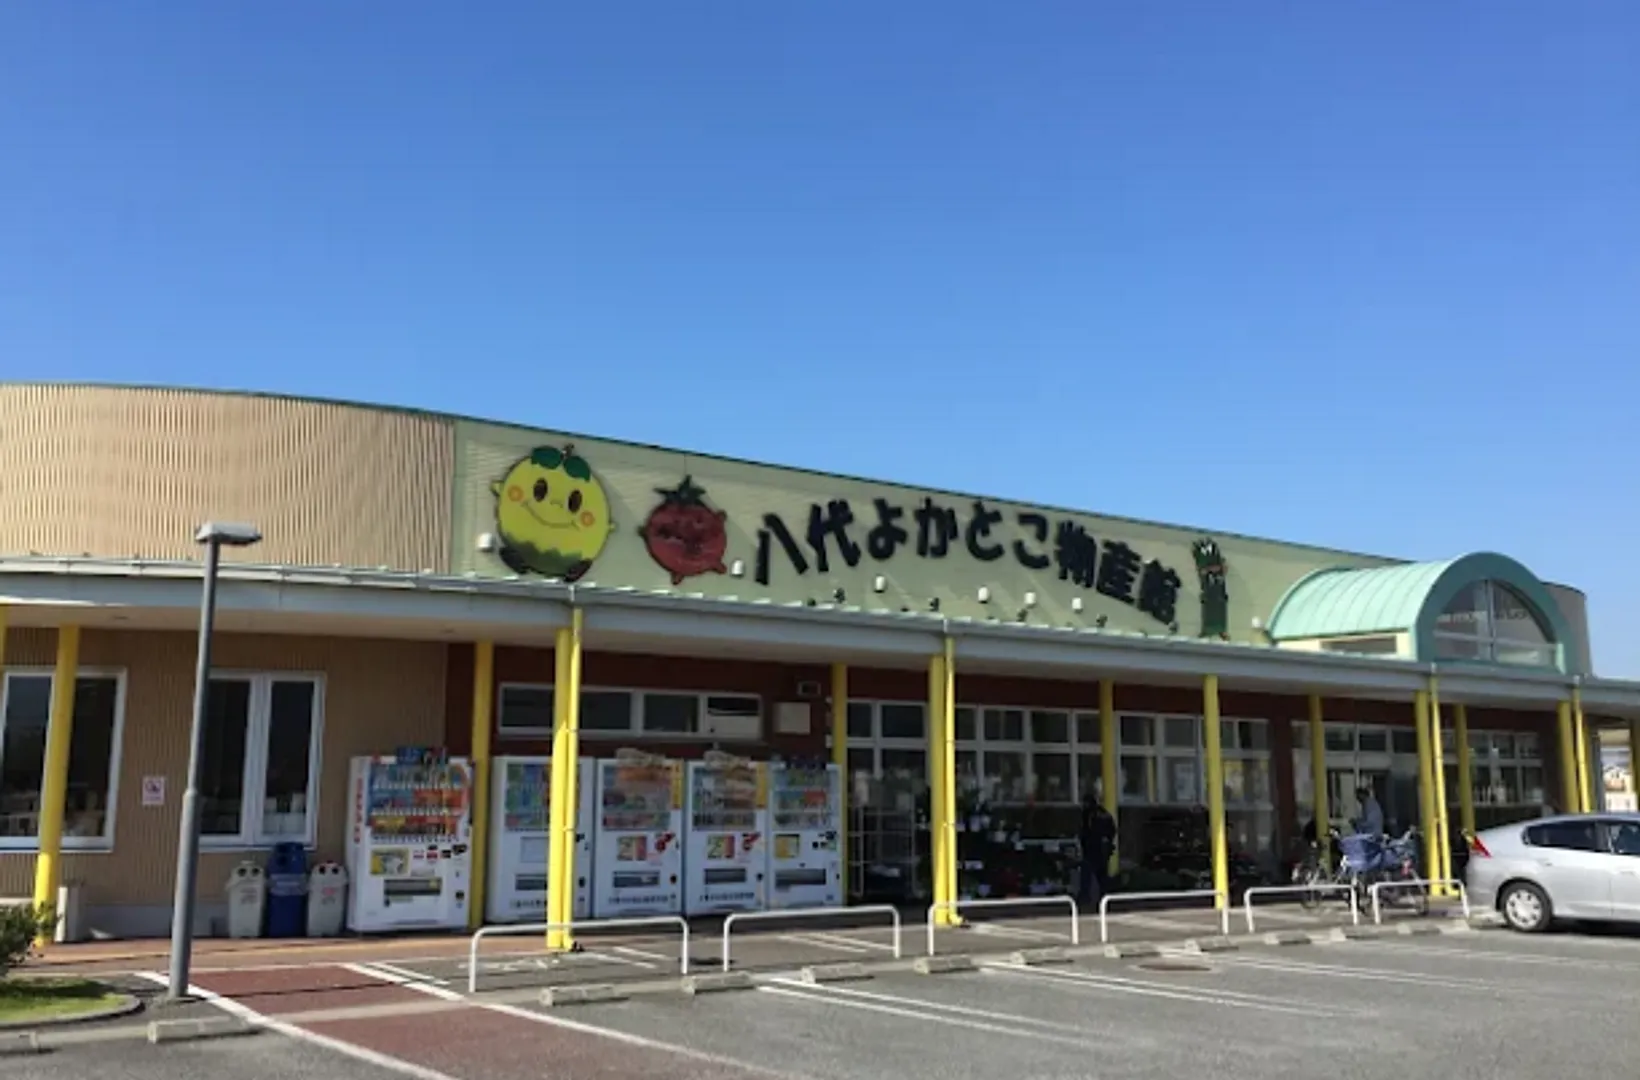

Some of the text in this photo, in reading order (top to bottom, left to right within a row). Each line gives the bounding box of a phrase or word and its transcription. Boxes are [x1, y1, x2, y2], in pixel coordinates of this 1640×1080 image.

[754, 497, 1181, 625] 八代よかとこ物産館
